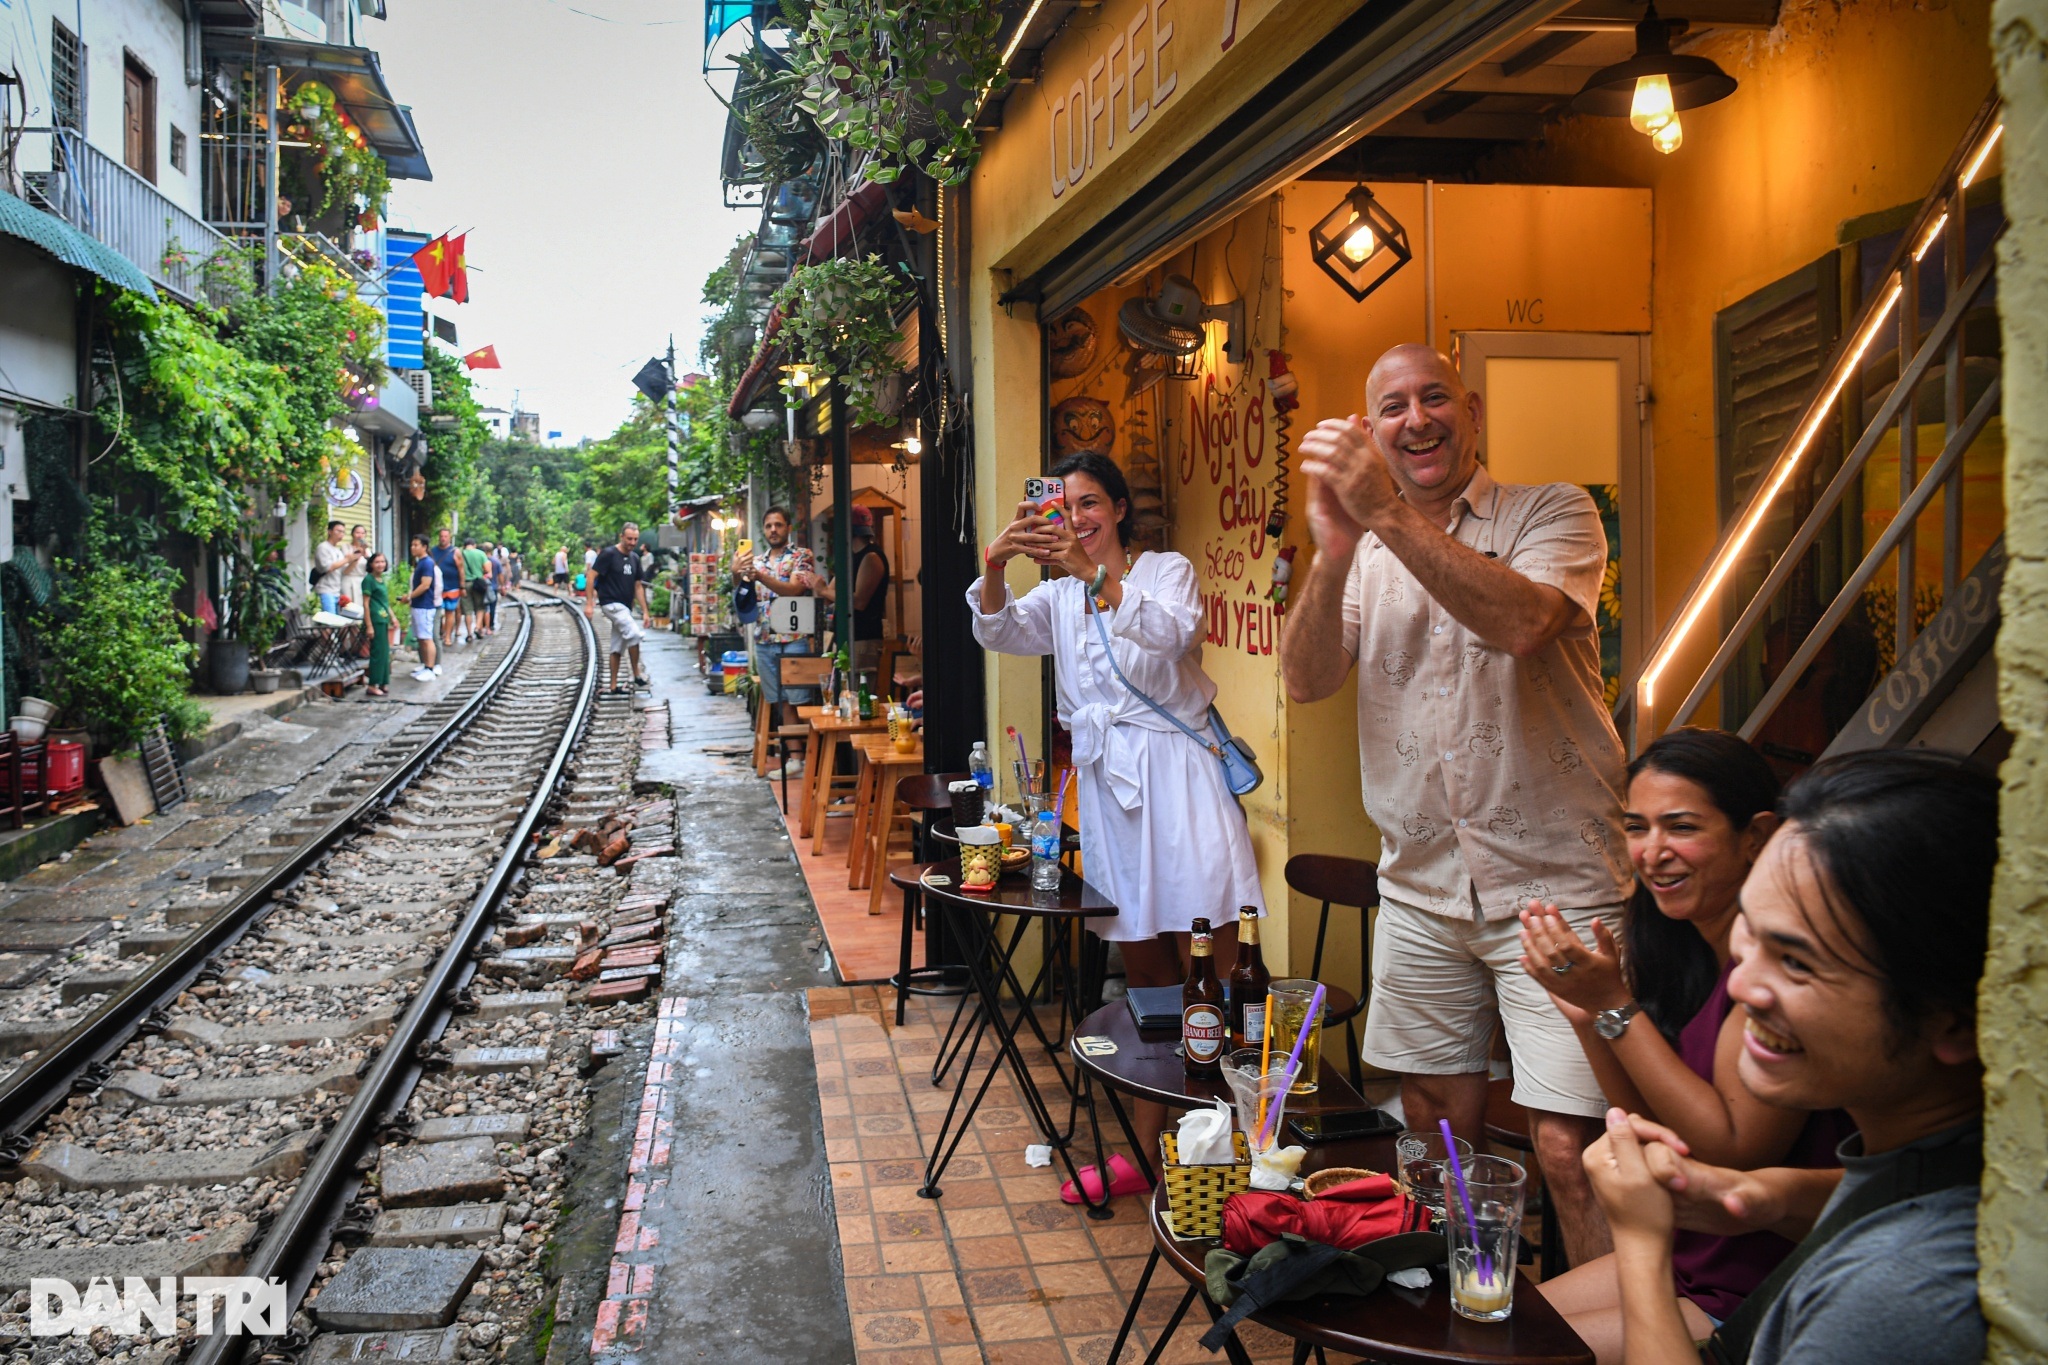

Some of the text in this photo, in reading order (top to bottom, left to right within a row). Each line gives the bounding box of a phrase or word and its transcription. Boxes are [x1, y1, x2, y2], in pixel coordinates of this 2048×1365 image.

[1051, 0, 1178, 199] COFFEE
[1506, 298, 1544, 324] WC
[1181, 372, 1238, 485] Ngồi
[1048, 483, 1062, 494] BE
[790, 600, 797, 613] 0
[790, 615, 799, 631] 9
[1867, 576, 1993, 734] coffee
[1184, 1023, 1223, 1038] HANOI BEER
